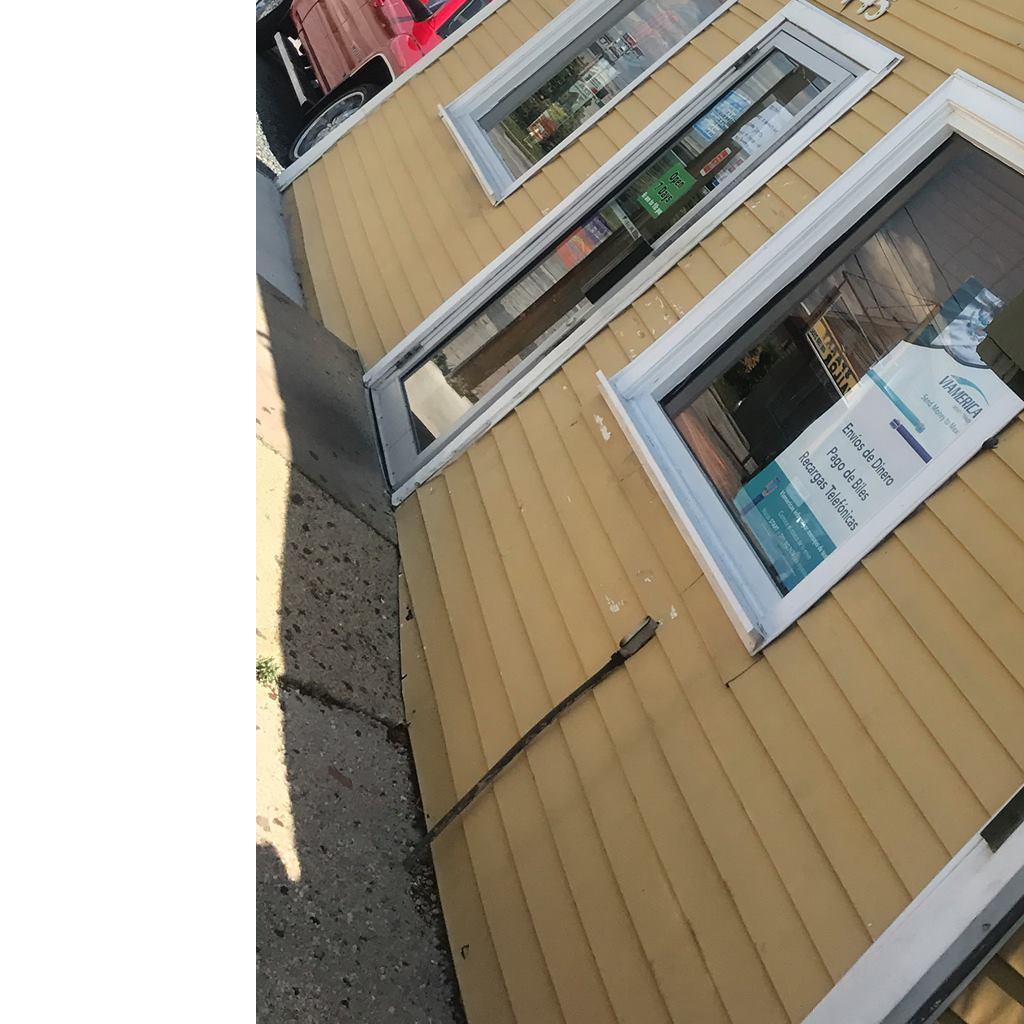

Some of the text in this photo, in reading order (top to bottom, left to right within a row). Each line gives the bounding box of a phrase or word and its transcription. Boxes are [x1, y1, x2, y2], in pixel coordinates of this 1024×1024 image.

[654, 182, 664, 190] 7
[657, 185, 673, 203] Days
[669, 171, 685, 188] Open
[841, 422, 894, 486] Envíos de Dinero
[798, 451, 828, 490] Recargas
[824, 485, 859, 532] Telefónicas
[826, 447, 870, 502] Pago de Biles
